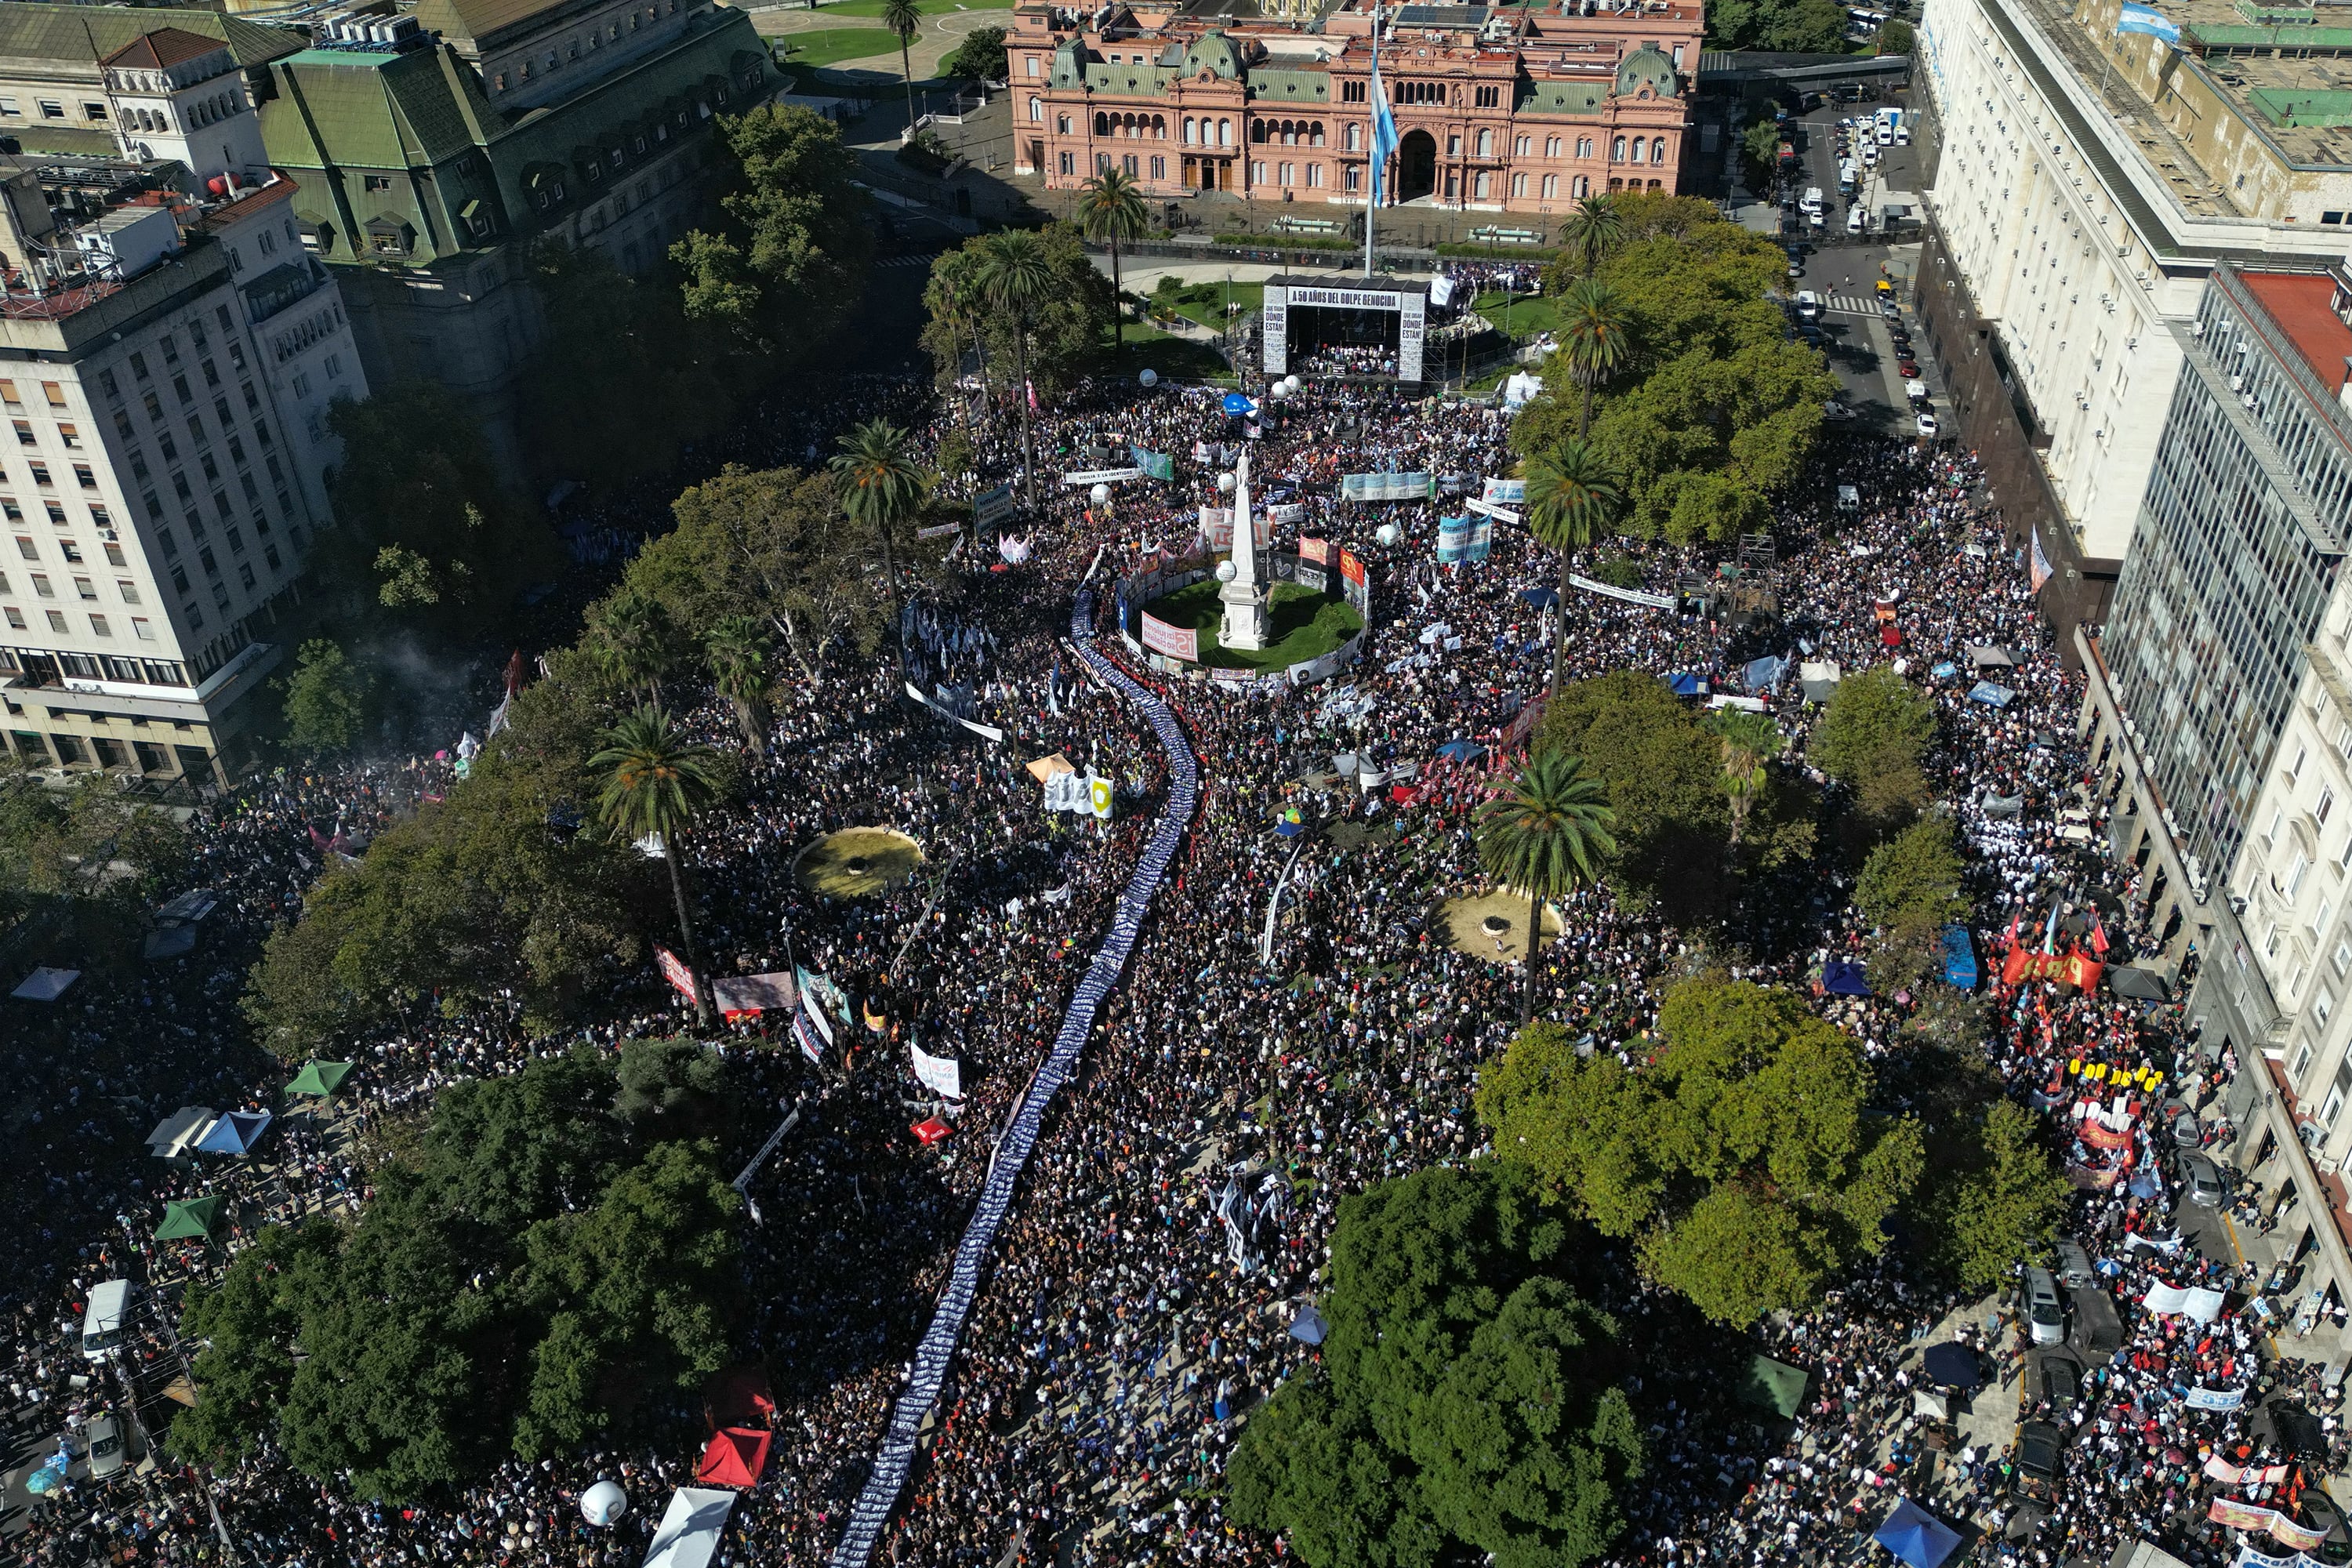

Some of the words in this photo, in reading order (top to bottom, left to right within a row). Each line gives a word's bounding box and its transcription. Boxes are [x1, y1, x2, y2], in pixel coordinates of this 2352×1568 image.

[1292, 290, 1297, 301] A
[1298, 291, 1307, 302] 50
[1308, 290, 1327, 303] AÑOS
[1328, 292, 1339, 304] DEL
[1340, 293, 1361, 305] GOLPE
[1363, 294, 1396, 307] GENOCIDA
[1266, 312, 1284, 322] DÓNDE
[1266, 322, 1284, 332] ESTÁN!
[1403, 319, 1422, 329] DÓNDE
[1403, 329, 1421, 339] ESTÁN!
